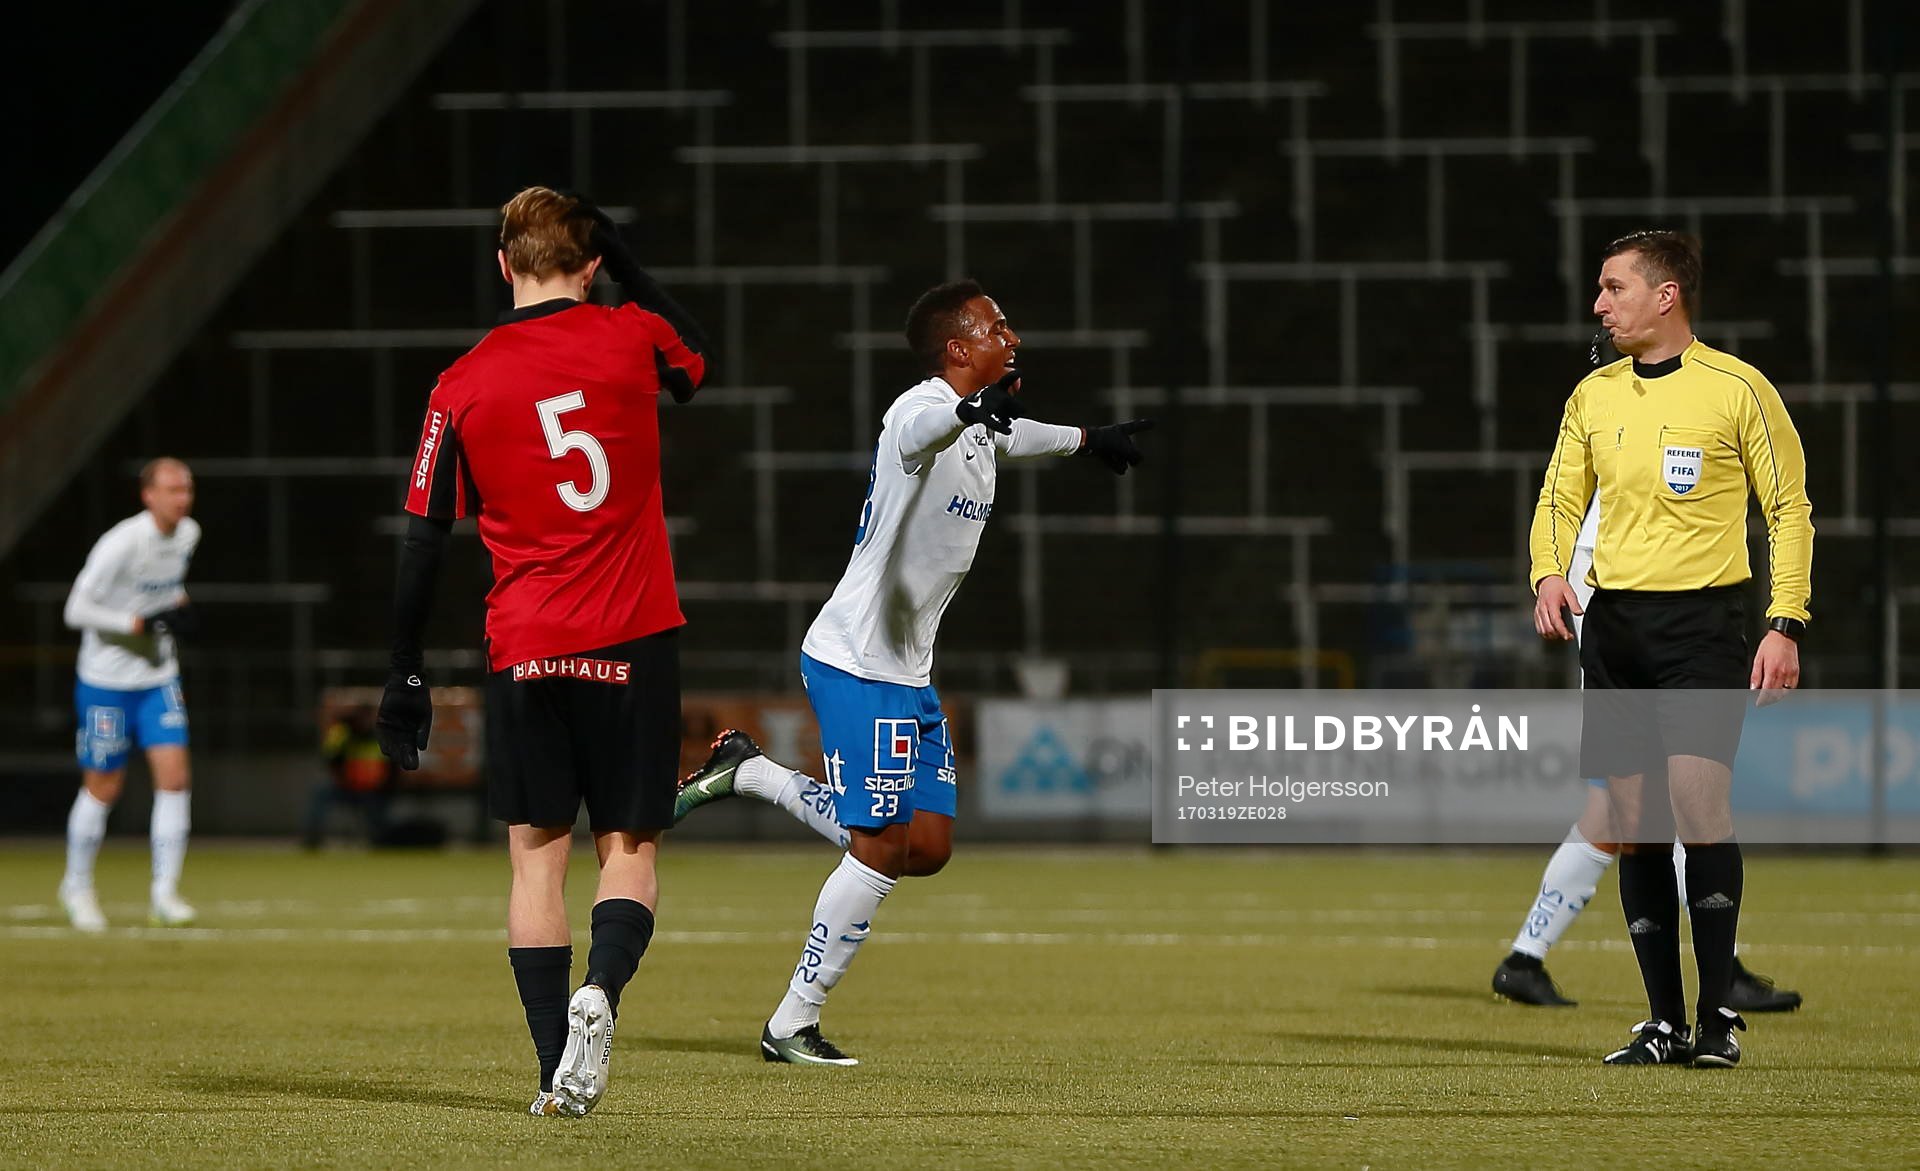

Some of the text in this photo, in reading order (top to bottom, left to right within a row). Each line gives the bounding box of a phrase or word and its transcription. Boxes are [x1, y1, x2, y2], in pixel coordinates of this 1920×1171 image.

[415, 410, 442, 490] stadium
[535, 390, 611, 512] 5
[1667, 449, 1701, 458] REFEREE
[1671, 466, 1695, 476] FIFA
[515, 659, 628, 681] BAUHAUS
[864, 775, 915, 792] stadiu
[871, 793, 898, 817] 23
